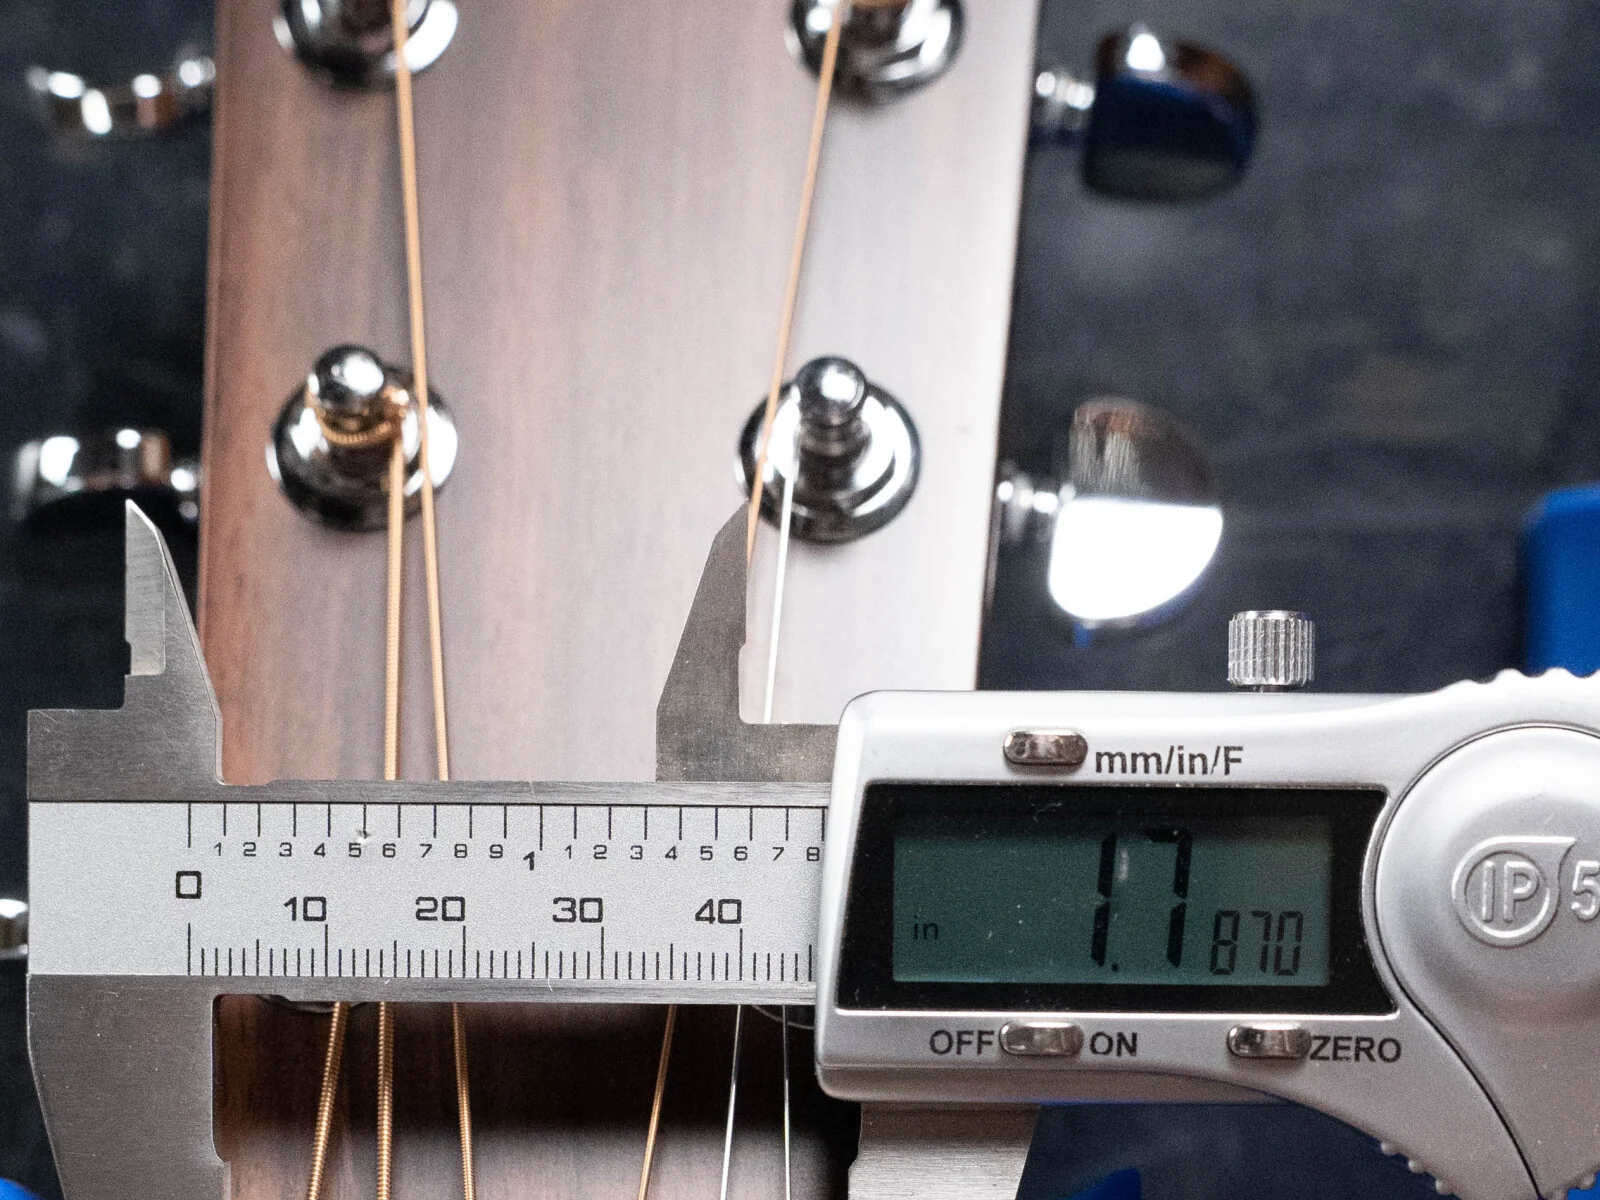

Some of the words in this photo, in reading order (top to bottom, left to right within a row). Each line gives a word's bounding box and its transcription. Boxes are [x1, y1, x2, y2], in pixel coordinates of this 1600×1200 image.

[1096, 747, 1242, 775] mm/in/F
[213, 842, 222, 856] 1
[243, 842, 256, 856] 2
[279, 842, 292, 857] 3
[314, 843, 325, 857] 4
[349, 843, 361, 858] 5
[383, 843, 396, 858] 6
[420, 844, 432, 857] 7
[454, 844, 467, 858] 8
[490, 844, 503, 858] 9
[523, 851, 534, 870] 1
[564, 844, 572, 859] 1
[594, 845, 607, 859] 2
[631, 845, 643, 860] 3
[665, 846, 677, 860] 4
[700, 846, 713, 860] 5
[734, 846, 747, 861] 6
[773, 847, 784, 860] 7
[807, 847, 820, 861] 8
[175, 871, 202, 899] 0
[1476, 860, 1541, 923] IP
[284, 897, 326, 921] 10
[416, 896, 465, 921] 20
[553, 897, 603, 923] 30
[695, 899, 741, 924] 40
[913, 914, 939, 940] in
[929, 1030, 994, 1055] OFF
[1090, 1032, 1137, 1056] ON
[1309, 1035, 1401, 1063] ZERO
